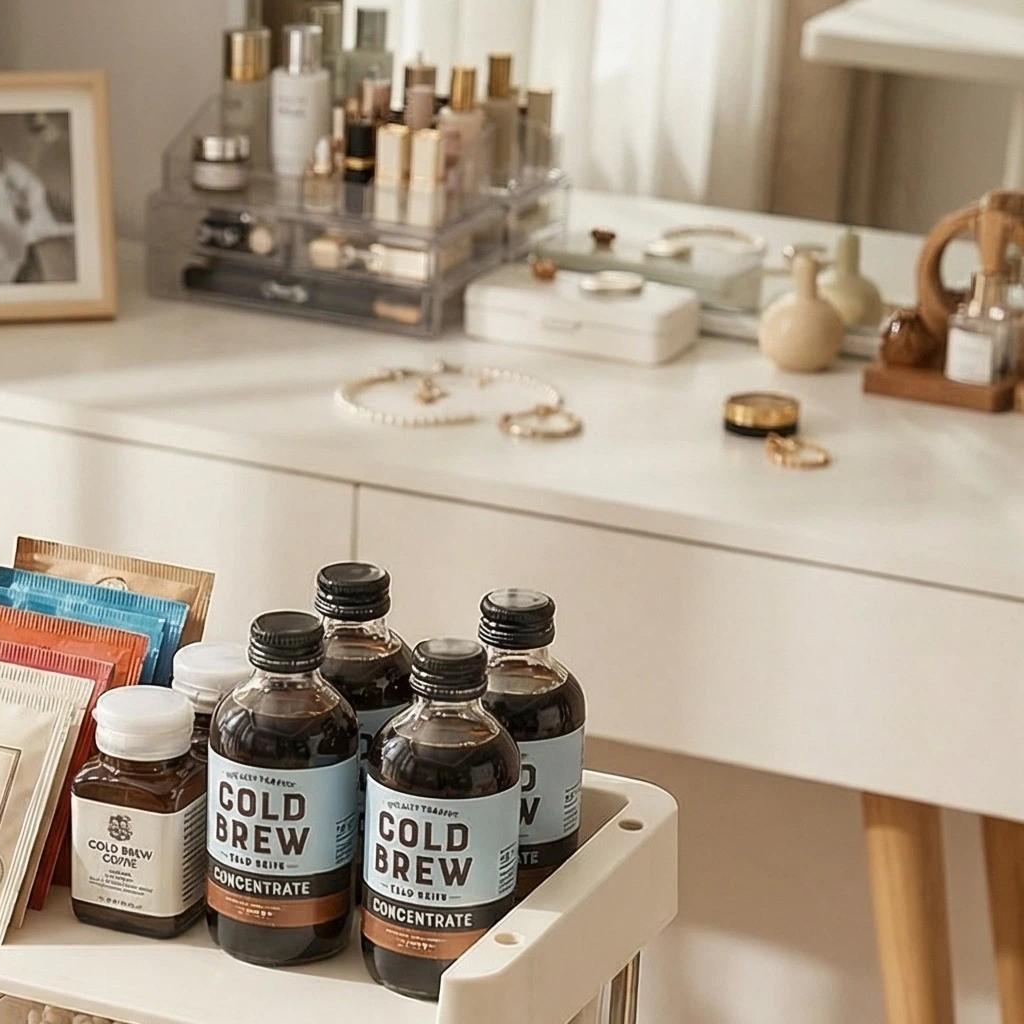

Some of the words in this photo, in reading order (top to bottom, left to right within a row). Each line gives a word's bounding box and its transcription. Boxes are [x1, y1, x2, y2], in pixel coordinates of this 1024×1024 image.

[219, 781, 307, 822] COLD
[88, 839, 119, 854] COLD
[215, 812, 311, 857] BREW
[379, 811, 470, 853] COLD
[213, 866, 311, 897] CONCENTRATE
[374, 843, 474, 888] BREW
[372, 898, 473, 929] CONCENTRATE
